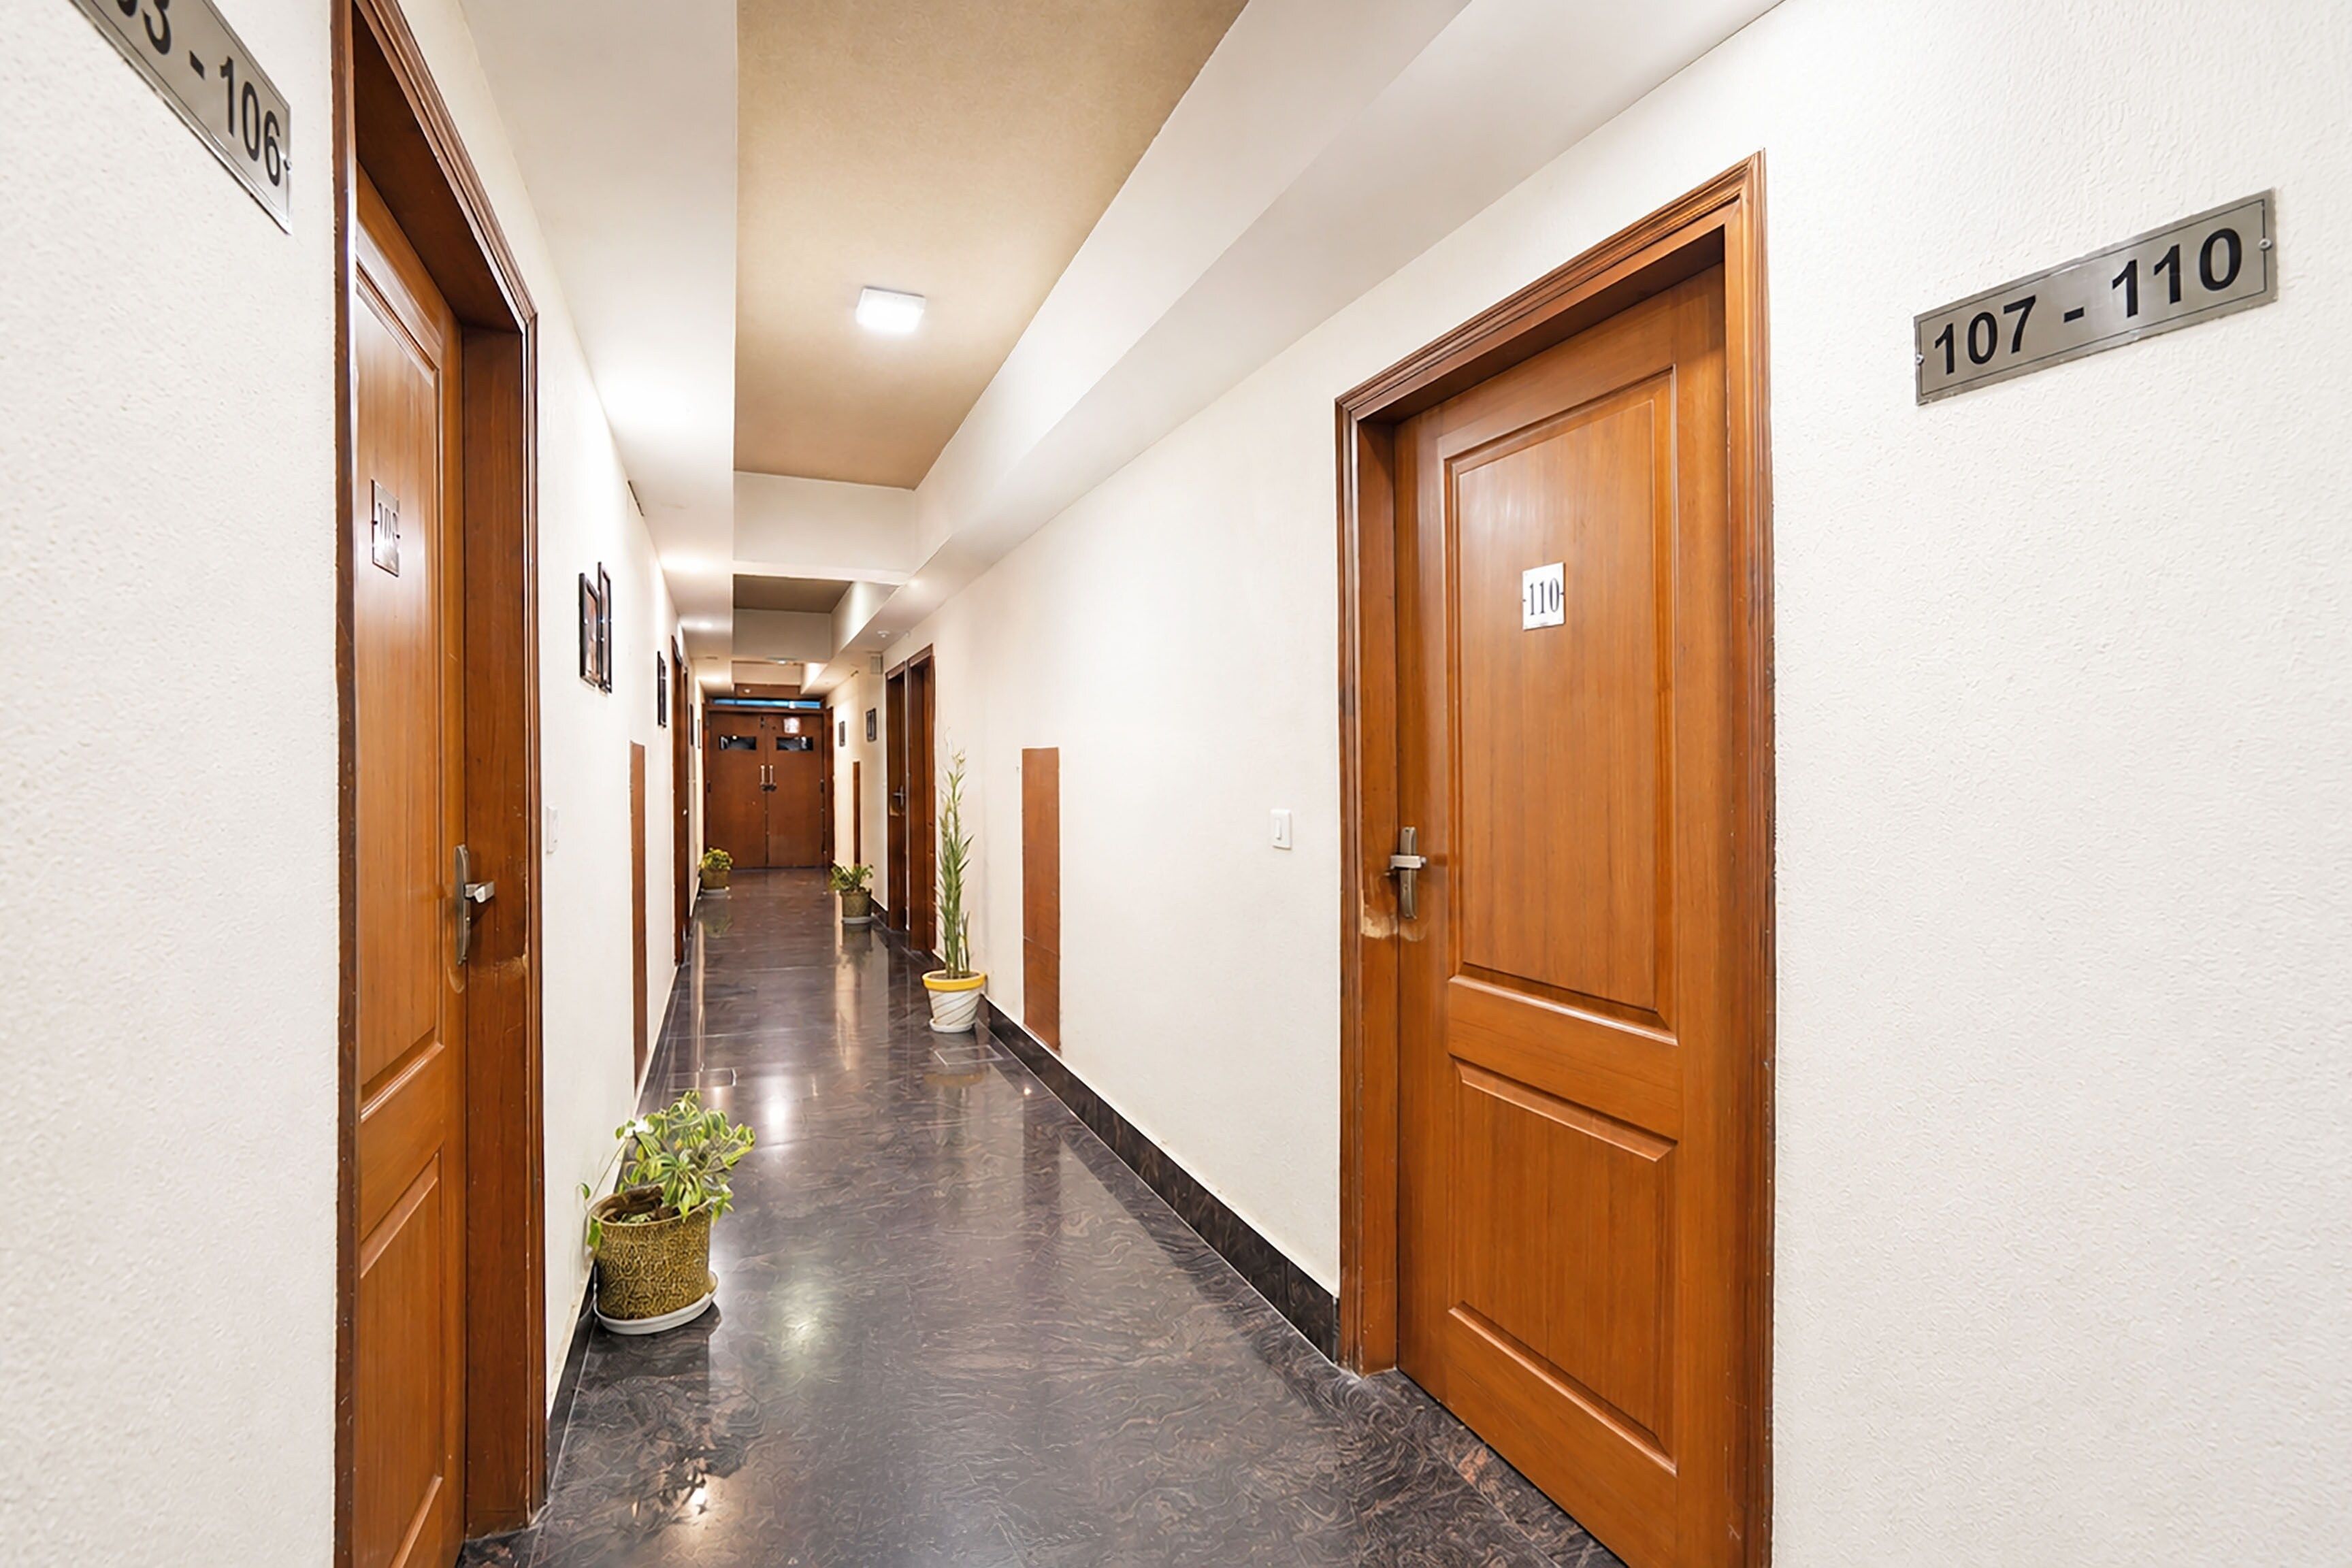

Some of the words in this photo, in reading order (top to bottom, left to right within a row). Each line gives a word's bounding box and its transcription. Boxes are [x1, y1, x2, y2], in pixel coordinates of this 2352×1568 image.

[116, 0, 171, 55] 3
[189, 50, 206, 80] -
[220, 56, 280, 187] 106
[1934, 295, 2037, 375] 107
[2063, 307, 2085, 323] -
[2112, 227, 2242, 318] 110
[1529, 577, 1560, 616] 110
